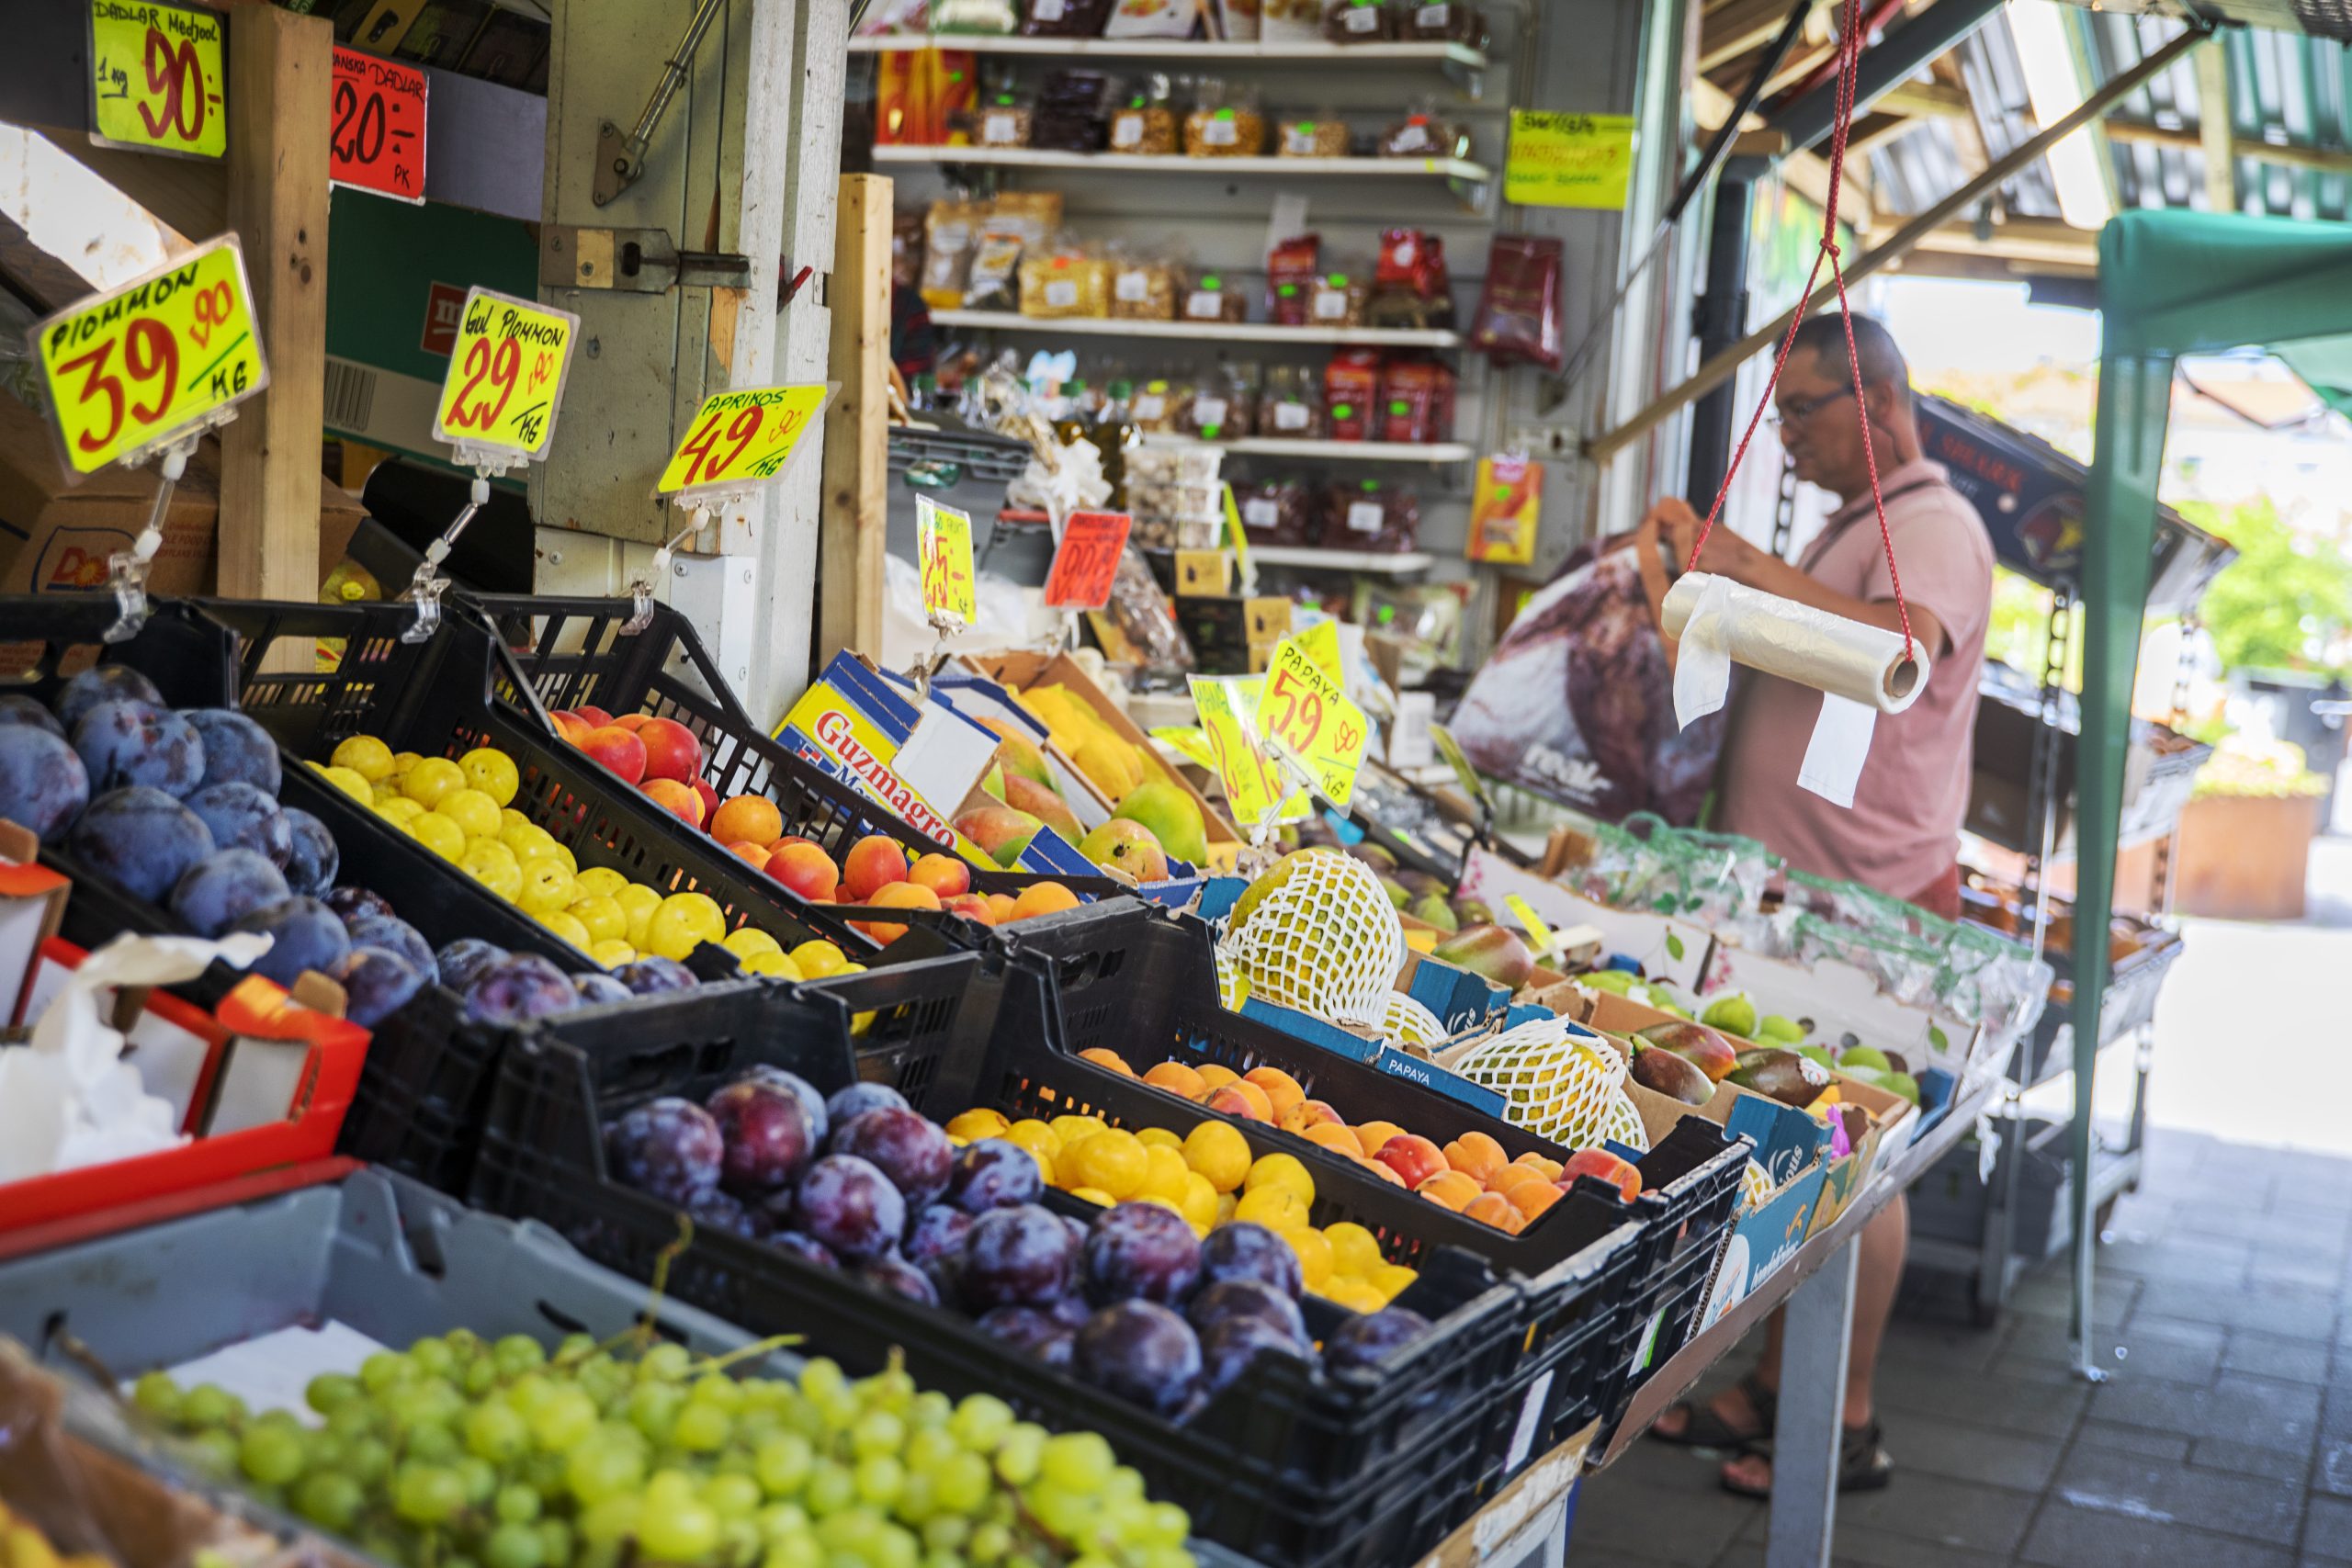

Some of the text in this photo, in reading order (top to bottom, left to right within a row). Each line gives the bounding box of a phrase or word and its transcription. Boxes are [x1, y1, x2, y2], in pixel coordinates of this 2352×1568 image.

[94, 2, 218, 43] DADLAR Medjool
[97, 56, 108, 82] 1
[368, 63, 426, 105] DADLAR
[394, 164, 411, 190] PK
[57, 318, 180, 453] 39
[211, 360, 248, 401] KG
[445, 337, 522, 432] 29
[701, 389, 787, 415] APRIKOS
[518, 413, 544, 445] KG
[679, 405, 764, 486] 49
[1281, 647, 1340, 705] PAPAYA
[1269, 669, 1323, 754] 59
[816, 712, 956, 849] Guzmagro
[1322, 771, 1346, 797] KG
[1388, 1058, 1430, 1087] PAPAYA
